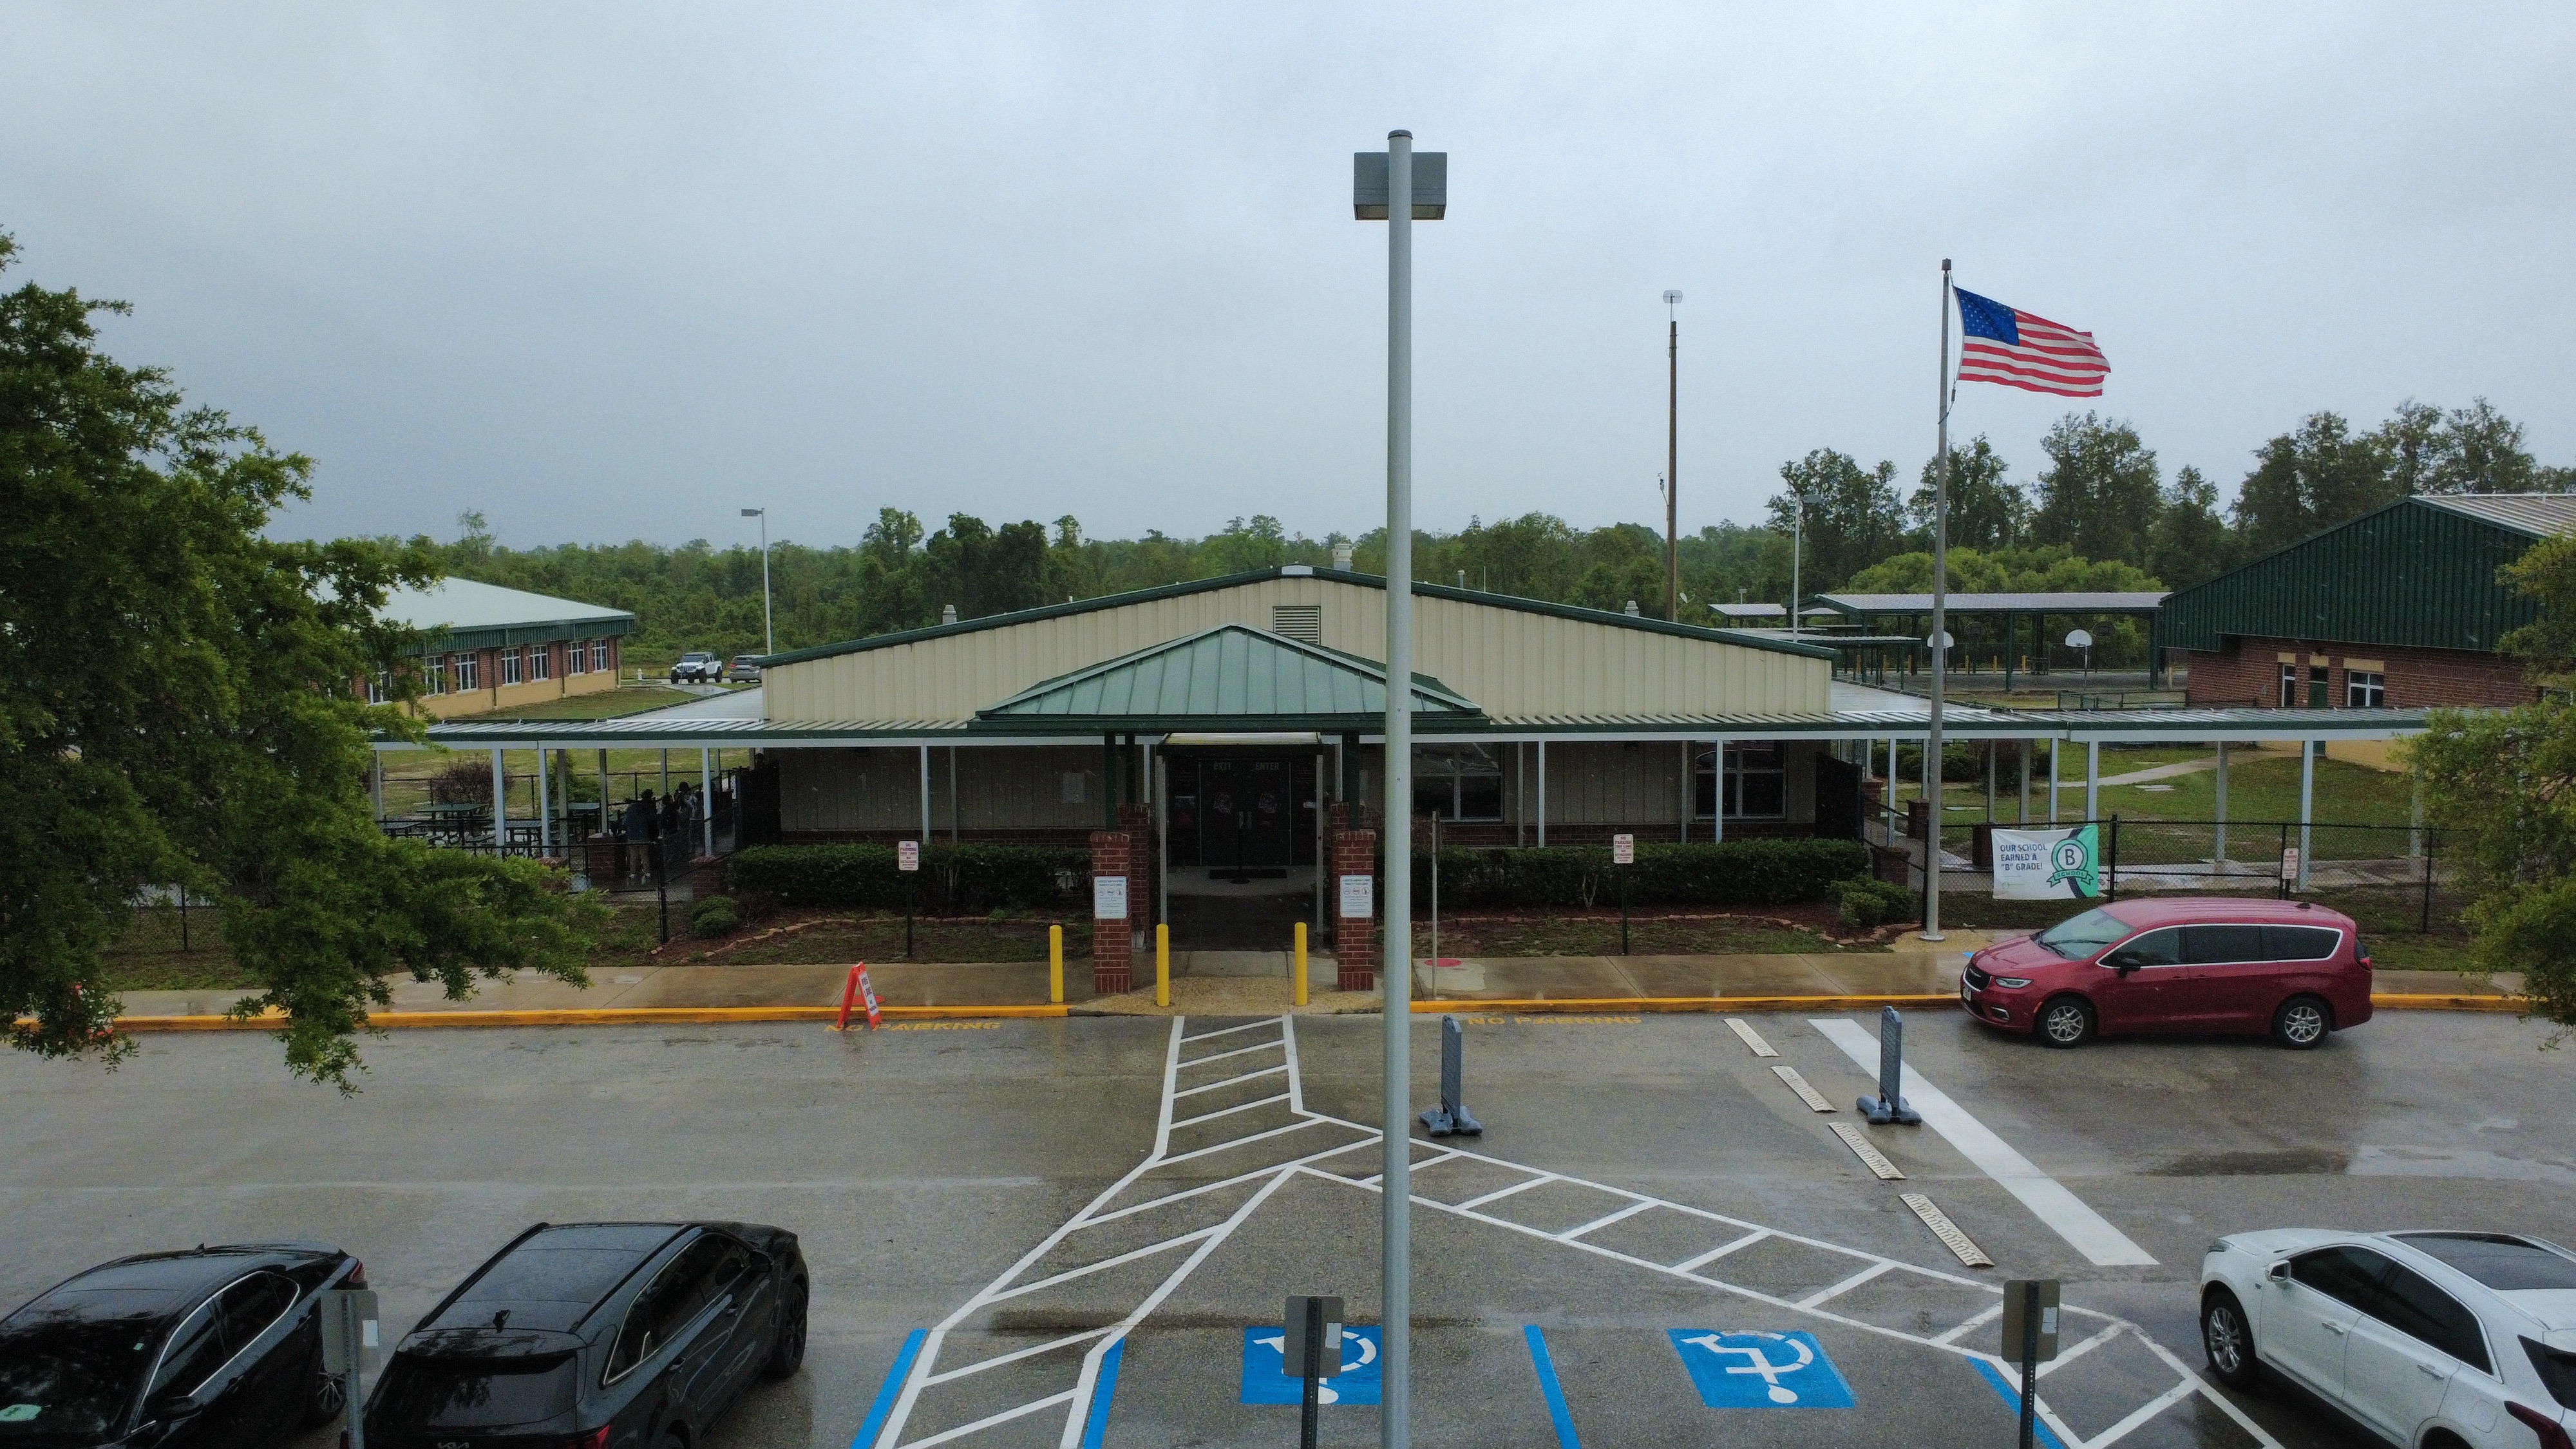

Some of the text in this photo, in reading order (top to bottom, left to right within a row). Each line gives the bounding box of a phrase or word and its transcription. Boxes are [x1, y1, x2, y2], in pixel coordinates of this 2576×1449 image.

[1213, 762, 1231, 770] EXIT
[1255, 762, 1279, 770] ENTER
[2001, 853, 2030, 862] EARNED
[2065, 849, 2076, 866] B
[1515, 1016, 1642, 1025] PARKING
[872, 1022, 1001, 1031] PARKING
